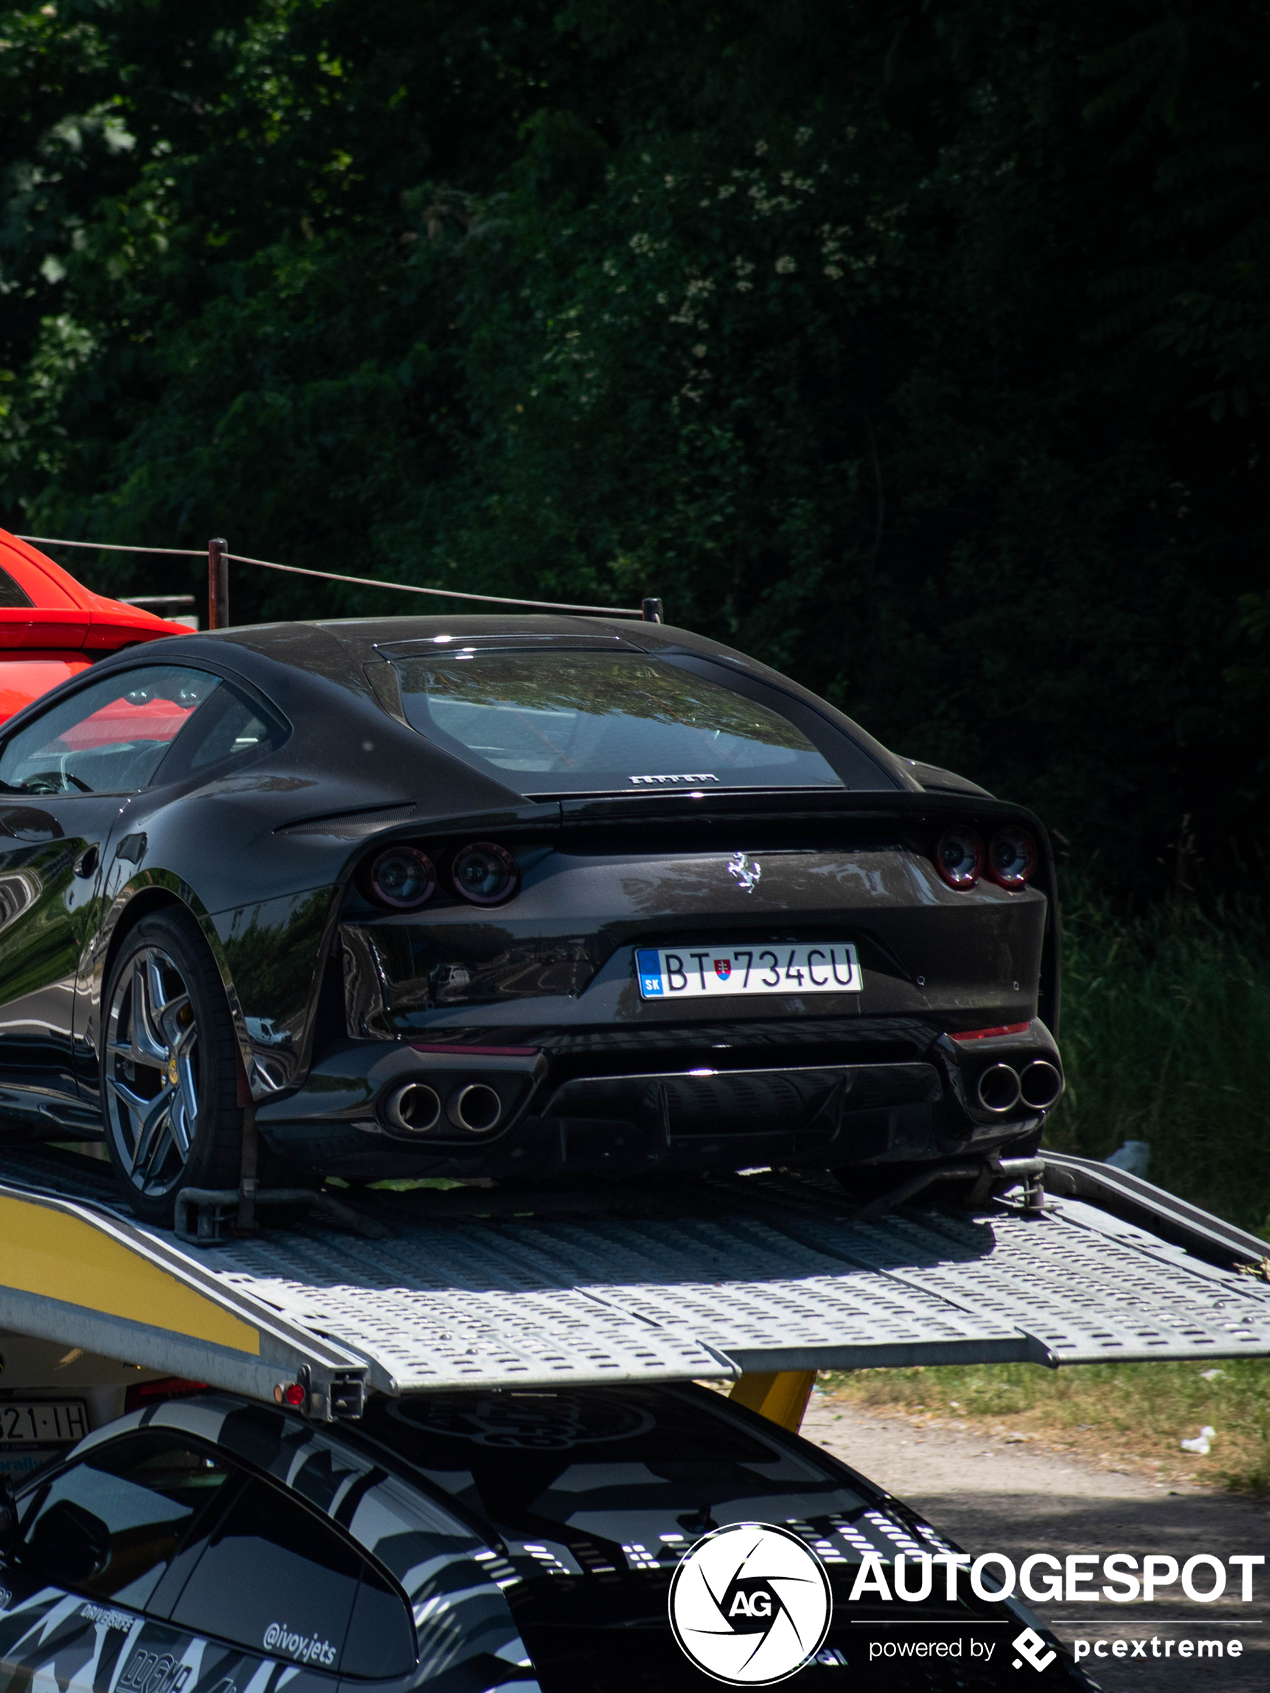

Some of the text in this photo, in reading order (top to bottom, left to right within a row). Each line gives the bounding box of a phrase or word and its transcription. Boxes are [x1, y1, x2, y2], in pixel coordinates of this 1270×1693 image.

[645, 978, 661, 991] SK
[664, 947, 853, 992] BT 734CU
[262, 1622, 338, 1666] @ivoy.jets
